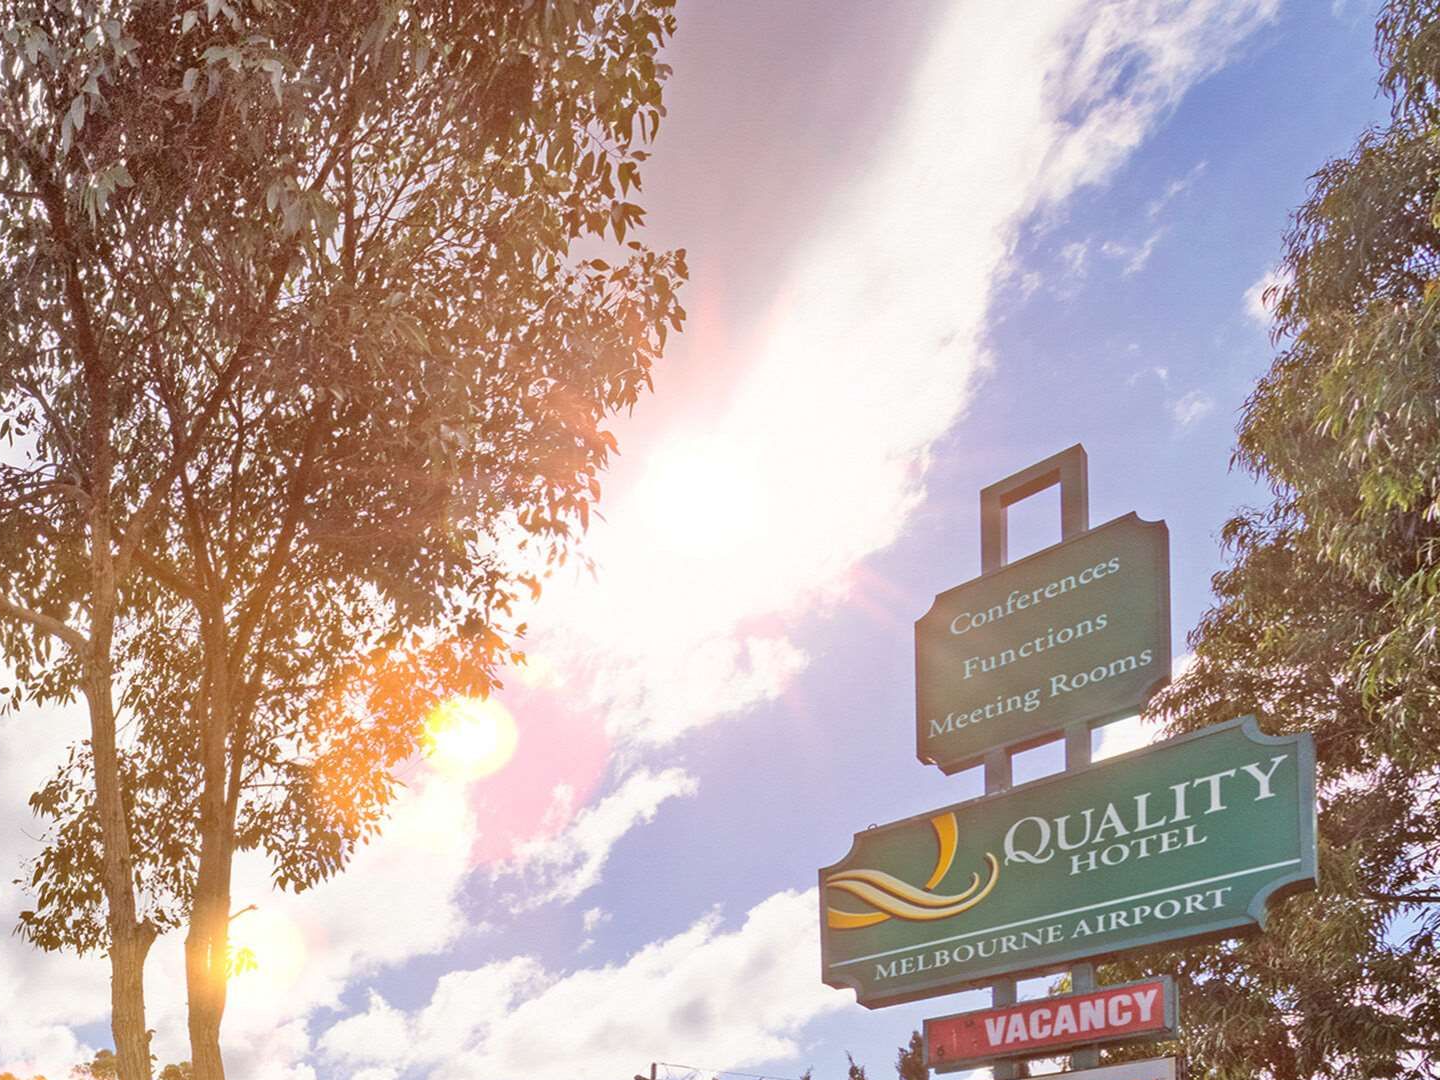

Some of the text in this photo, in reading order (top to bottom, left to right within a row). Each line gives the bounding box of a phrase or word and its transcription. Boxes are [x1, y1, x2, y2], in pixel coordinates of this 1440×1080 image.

[949, 556, 1121, 635] Conferences
[962, 613, 1109, 680] Functions
[927, 648, 1153, 739] Meeting Rooms
[1003, 753, 1289, 867] QUALITY
[1068, 824, 1208, 876] HOTEL
[873, 886, 1232, 981] MELBOURNE AIRPORT
[984, 988, 1158, 1047] VACANCY
